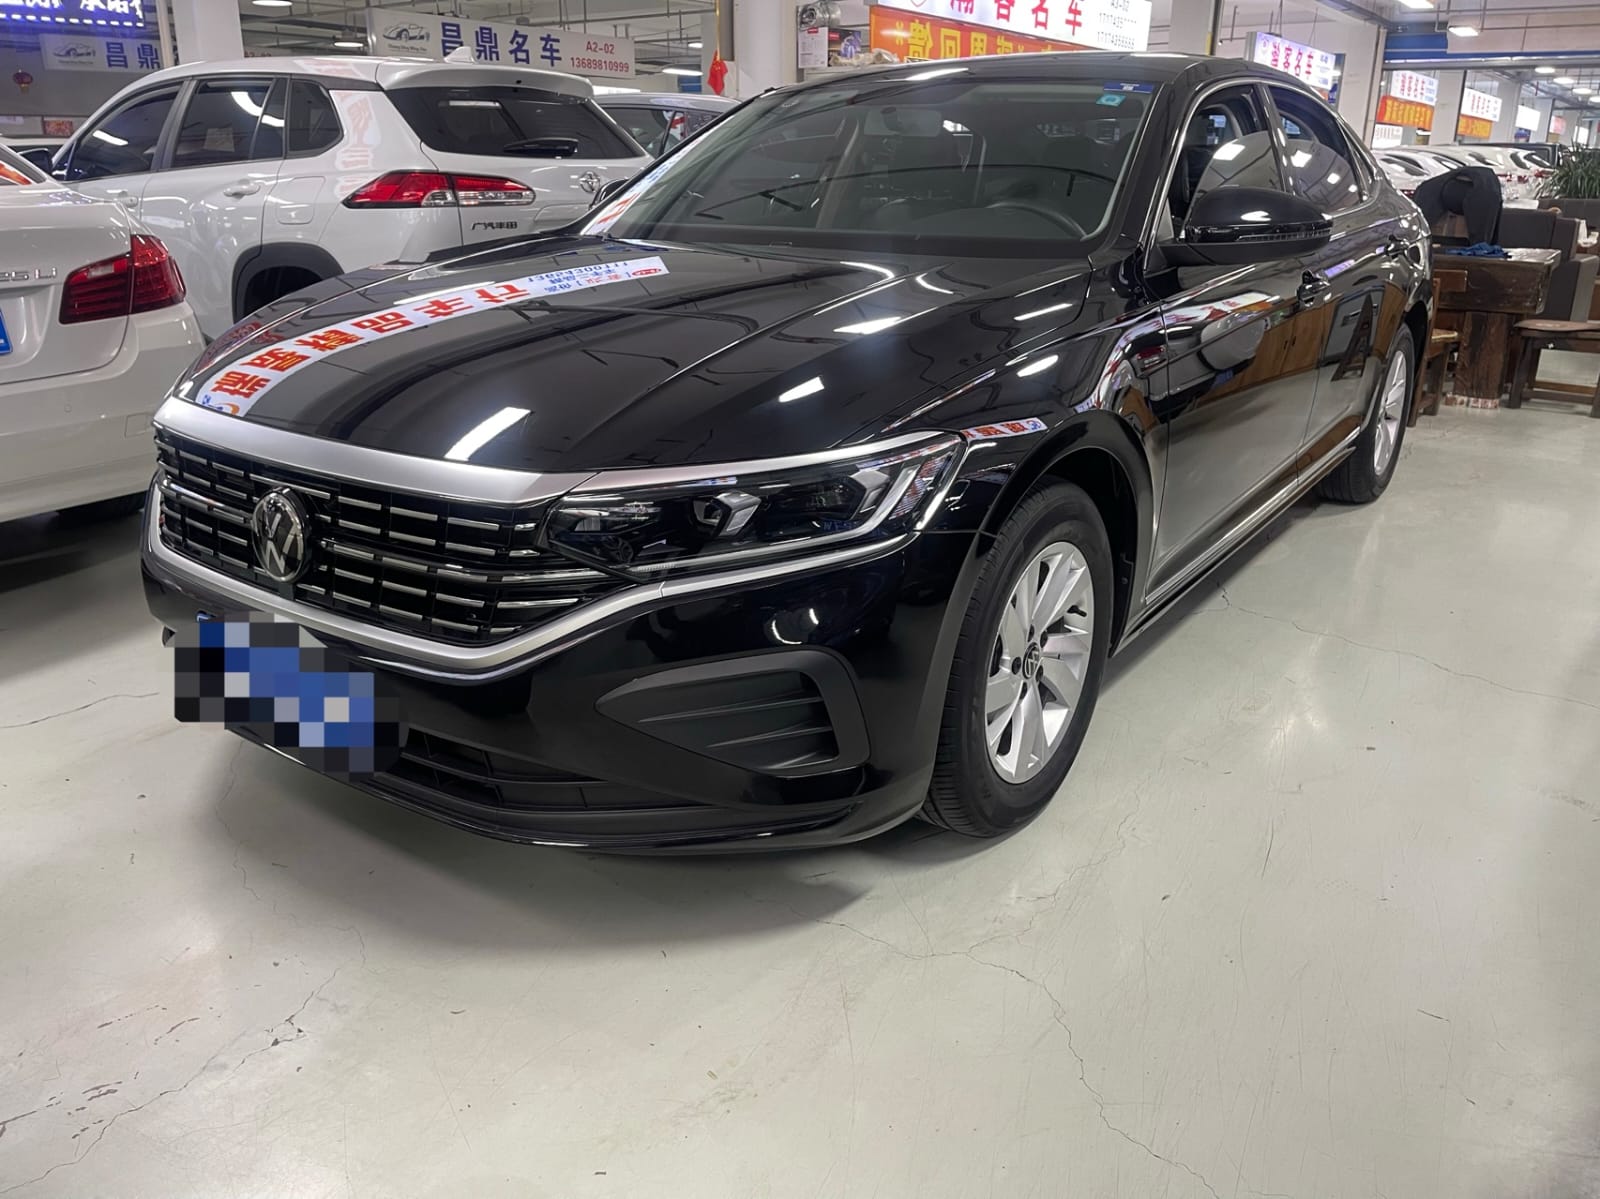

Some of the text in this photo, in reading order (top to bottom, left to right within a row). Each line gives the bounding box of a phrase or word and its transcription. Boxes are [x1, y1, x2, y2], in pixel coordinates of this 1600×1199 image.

[440, 21, 563, 67] 昌鼎名车
[585, 40, 616, 55] A2-02
[570, 56, 630, 73] 13689810999
[471, 221, 518, 231] 广汽丰田
